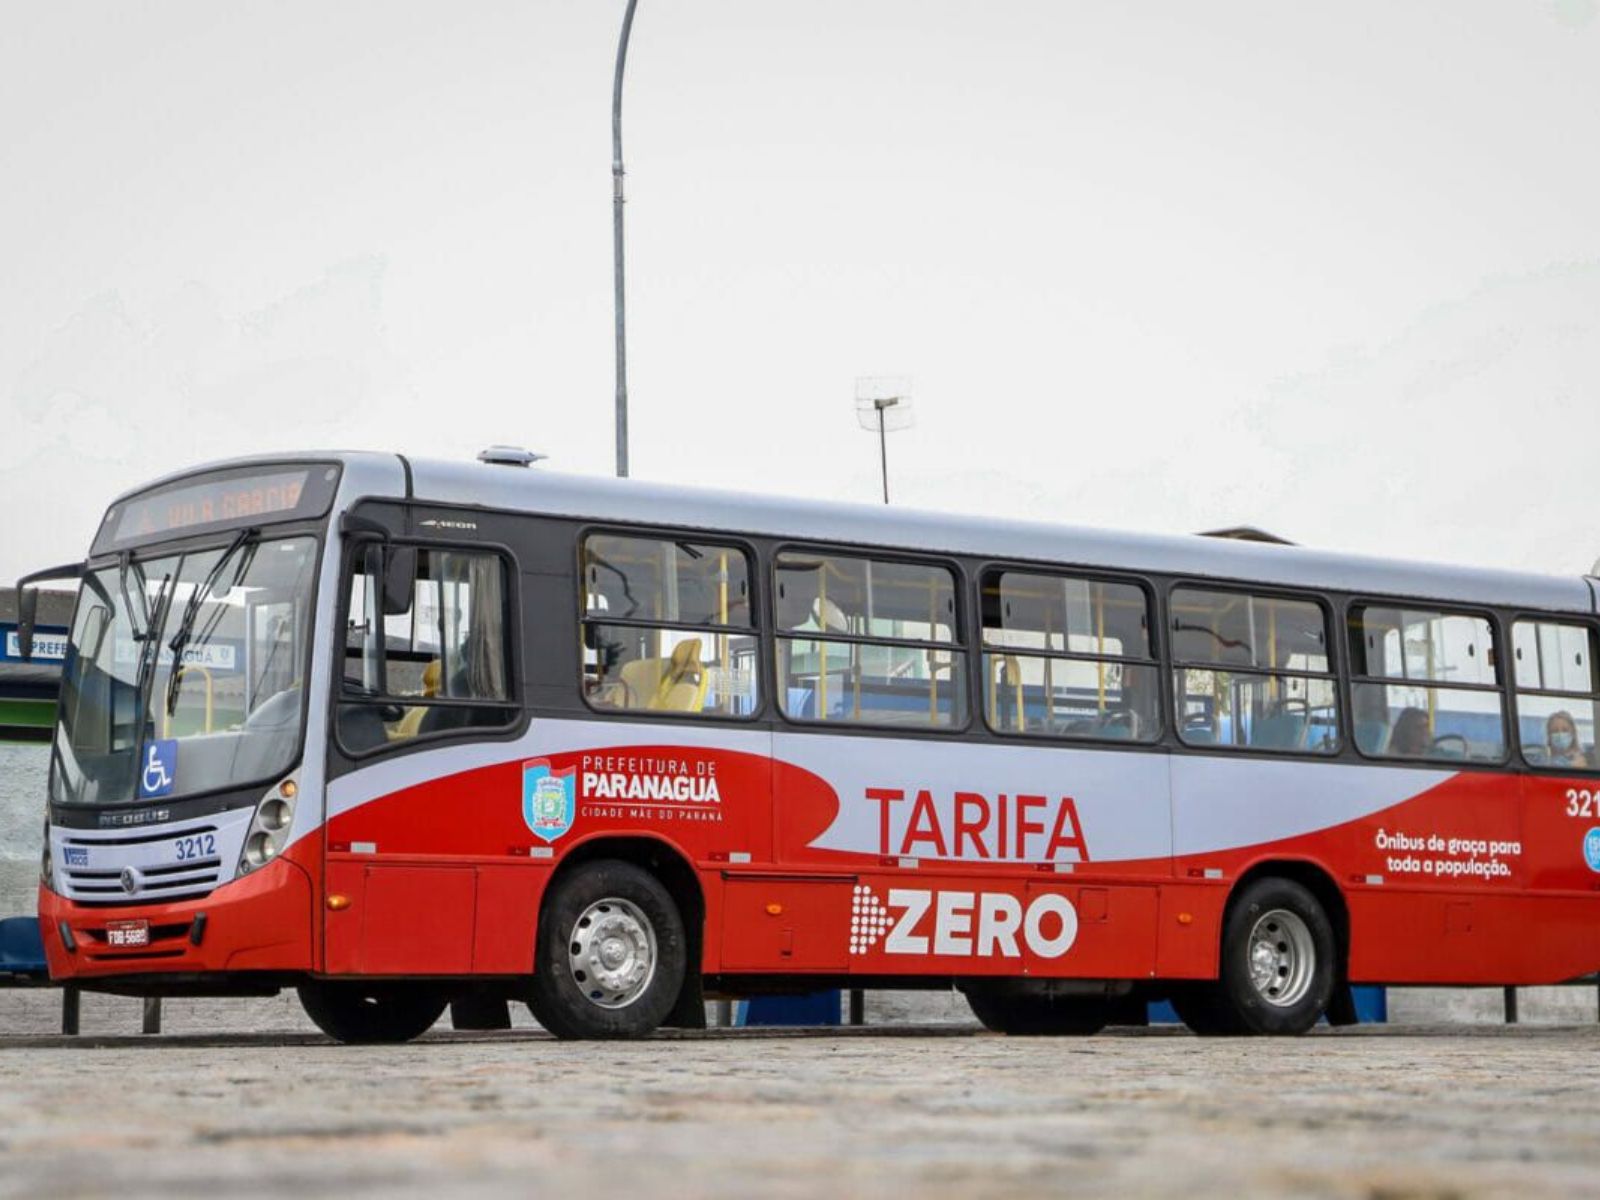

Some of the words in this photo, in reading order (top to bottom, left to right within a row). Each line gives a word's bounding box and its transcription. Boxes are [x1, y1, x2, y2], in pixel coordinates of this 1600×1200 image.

[583, 755, 689, 775] PREFEITURA
[696, 761, 716, 776] DE
[581, 806, 624, 819] CIDADE
[865, 787, 1090, 862] TARIFA
[175, 834, 216, 860] 3212
[1376, 828, 1425, 851] Ônibus
[1427, 834, 1446, 852] de
[1448, 838, 1487, 858] graça
[1489, 840, 1521, 858] para
[1387, 855, 1420, 872] toda
[1423, 860, 1433, 873] a
[1435, 858, 1511, 879] população.
[885, 888, 1078, 959] ZERO
